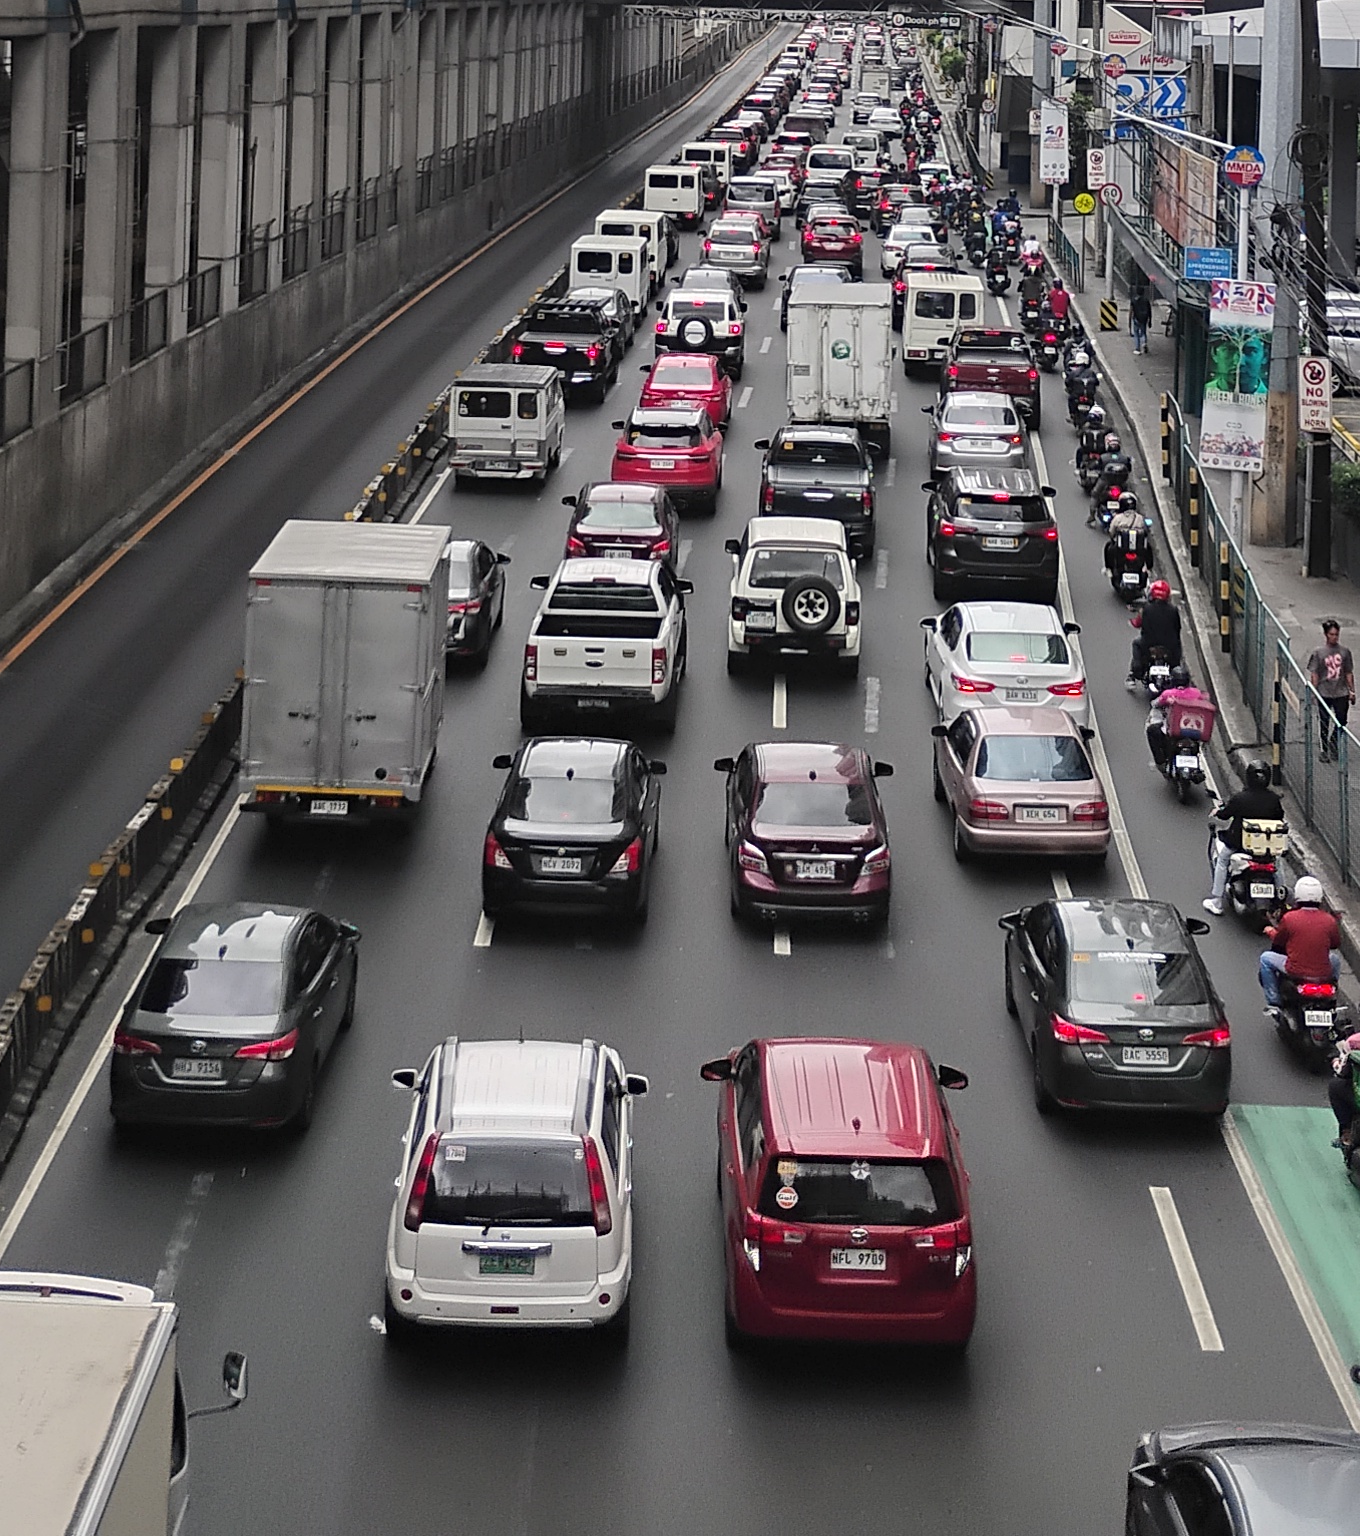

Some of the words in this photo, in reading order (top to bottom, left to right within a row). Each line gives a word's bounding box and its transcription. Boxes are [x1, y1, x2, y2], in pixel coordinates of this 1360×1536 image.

[1227, 162, 1261, 173] MMDA
[1104, 189, 1118, 199] 60
[1306, 387, 1324, 398] NO
[1301, 398, 1329, 408] BLOWING
[1310, 409, 1321, 417] OF
[1304, 419, 1327, 428] HORN
[831, 1252, 851, 1264] NFL
[857, 1252, 884, 1266] 9709
